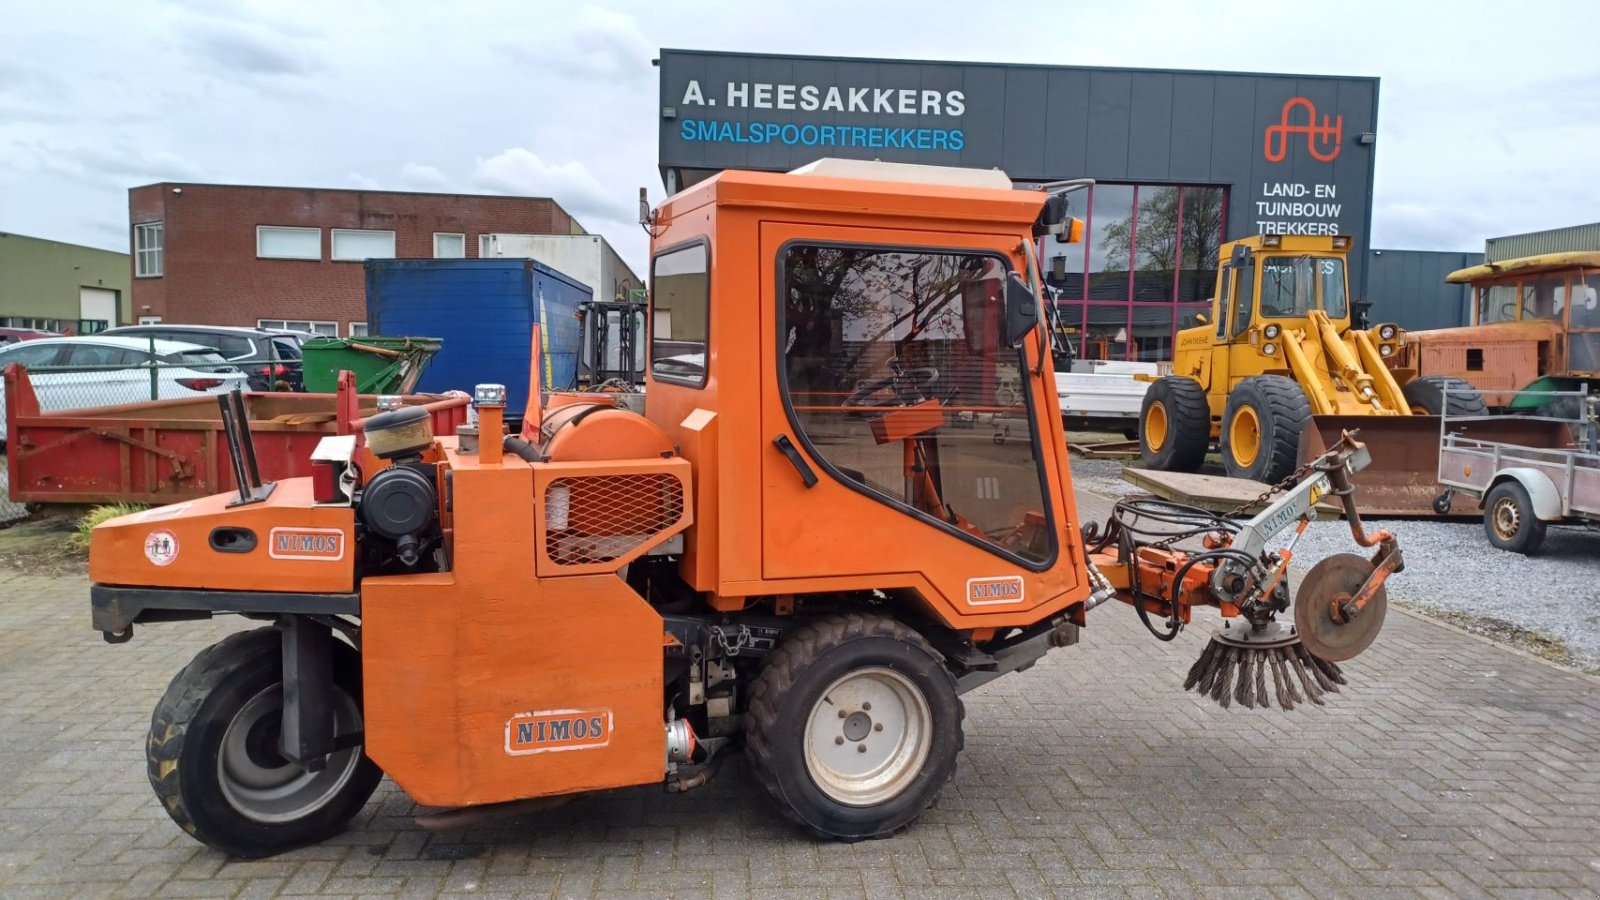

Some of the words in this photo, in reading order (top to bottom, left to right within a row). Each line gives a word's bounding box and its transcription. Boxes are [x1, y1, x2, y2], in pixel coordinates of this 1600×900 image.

[682, 80, 716, 106] A.
[727, 82, 966, 116] HEESAKKERS
[681, 119, 965, 151] SMALSPOORTREKKERS
[1263, 182, 1310, 198] LAND-
[1314, 184, 1337, 198] EN
[1256, 201, 1342, 218] TUINBOUW
[1256, 221, 1339, 236] TREKKERS
[277, 534, 338, 553] NIMOS
[972, 582, 1019, 599] NIMOS
[516, 716, 604, 745] NIMOS
